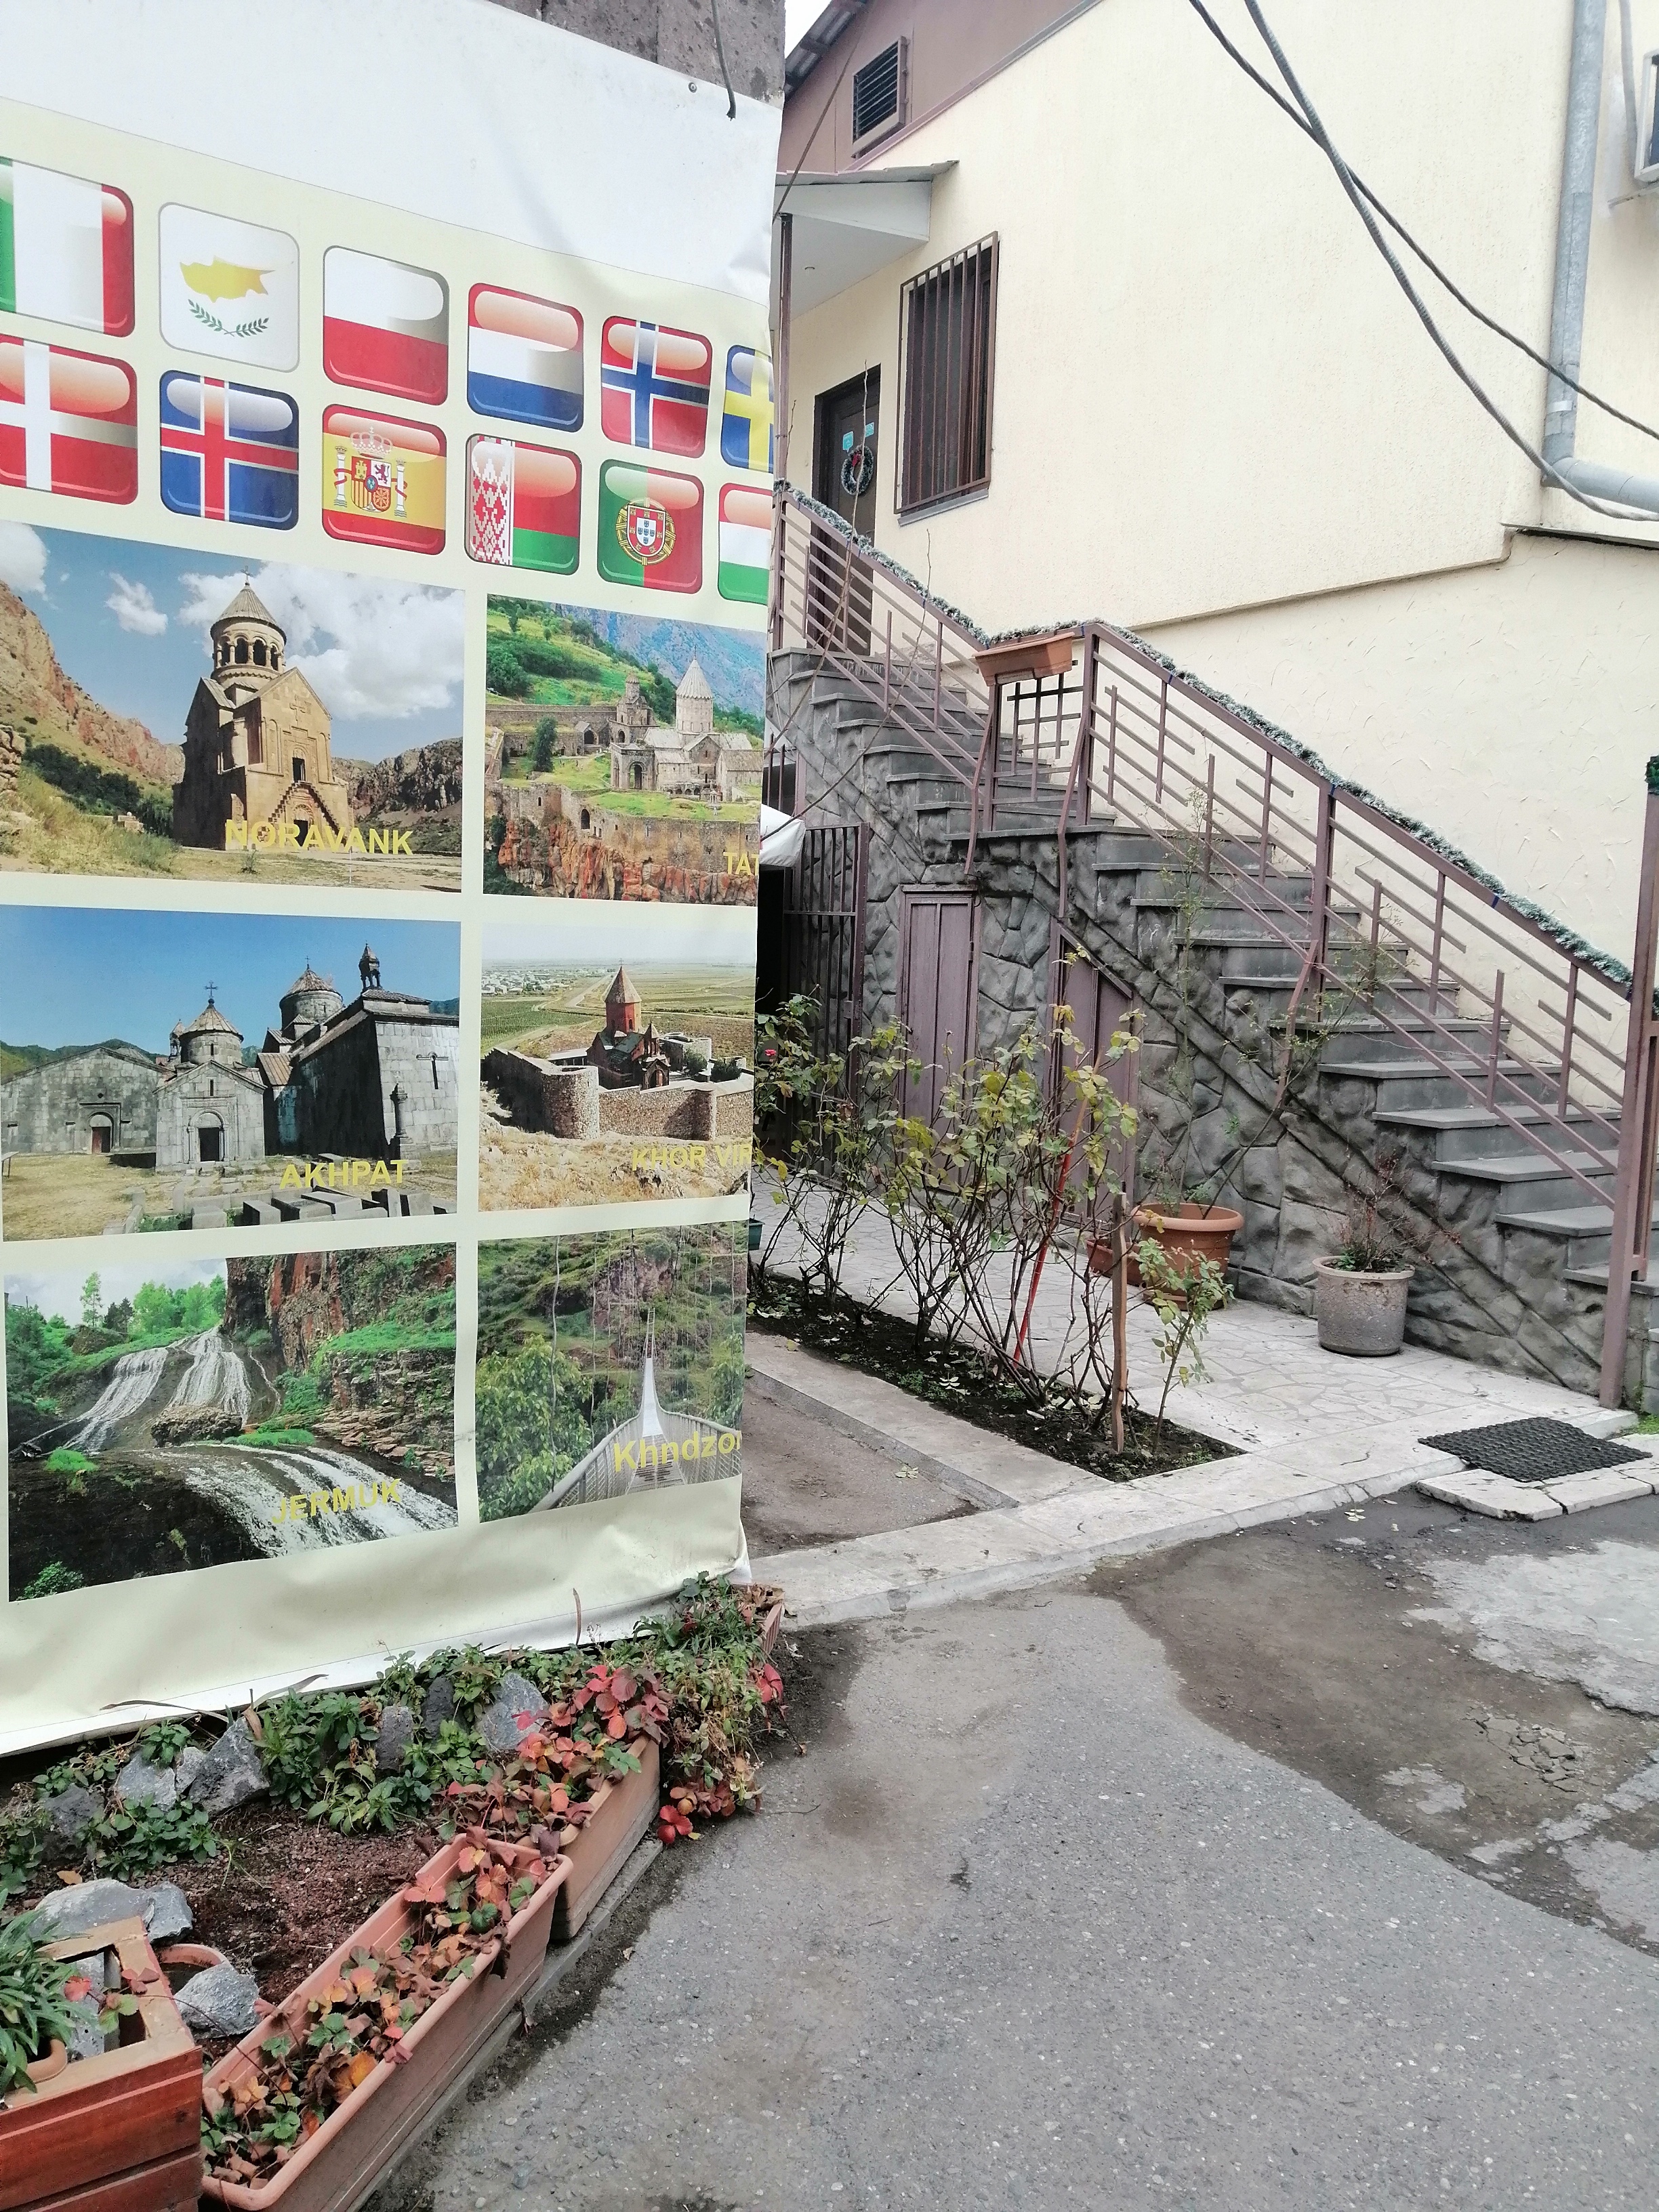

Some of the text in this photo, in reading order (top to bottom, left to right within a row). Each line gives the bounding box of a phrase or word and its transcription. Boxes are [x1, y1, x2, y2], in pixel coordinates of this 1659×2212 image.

[225, 819, 413, 855] NORAVANK
[279, 1159, 409, 1189] AKHPAT
[632, 1146, 706, 1171] KHOR
[272, 1477, 401, 1523] JERMUK
